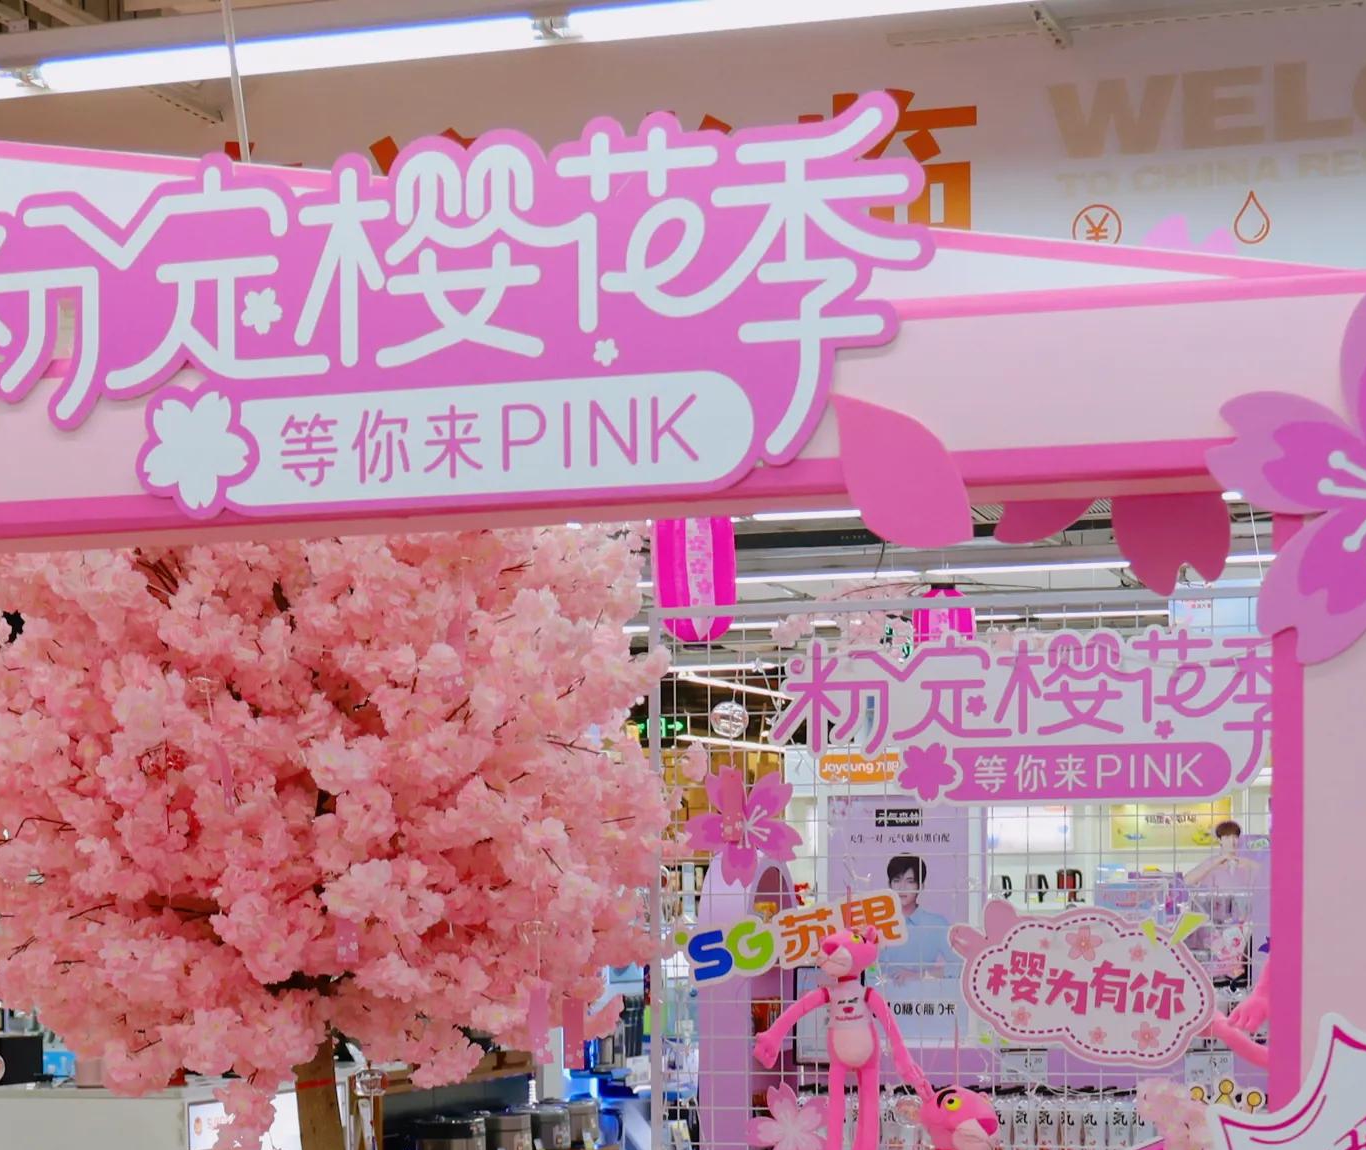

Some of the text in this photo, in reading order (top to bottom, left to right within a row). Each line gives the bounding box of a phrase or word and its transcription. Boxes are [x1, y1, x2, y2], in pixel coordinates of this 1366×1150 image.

[1129, 159, 1290, 196] CHINA
[280, 394, 701, 482] 等你来PINK
[821, 761, 874, 774] Joyoung
[974, 753, 1204, 794] 等你来PINK
[688, 920, 774, 981] SG
[987, 949, 1186, 1021] 樱为有你
